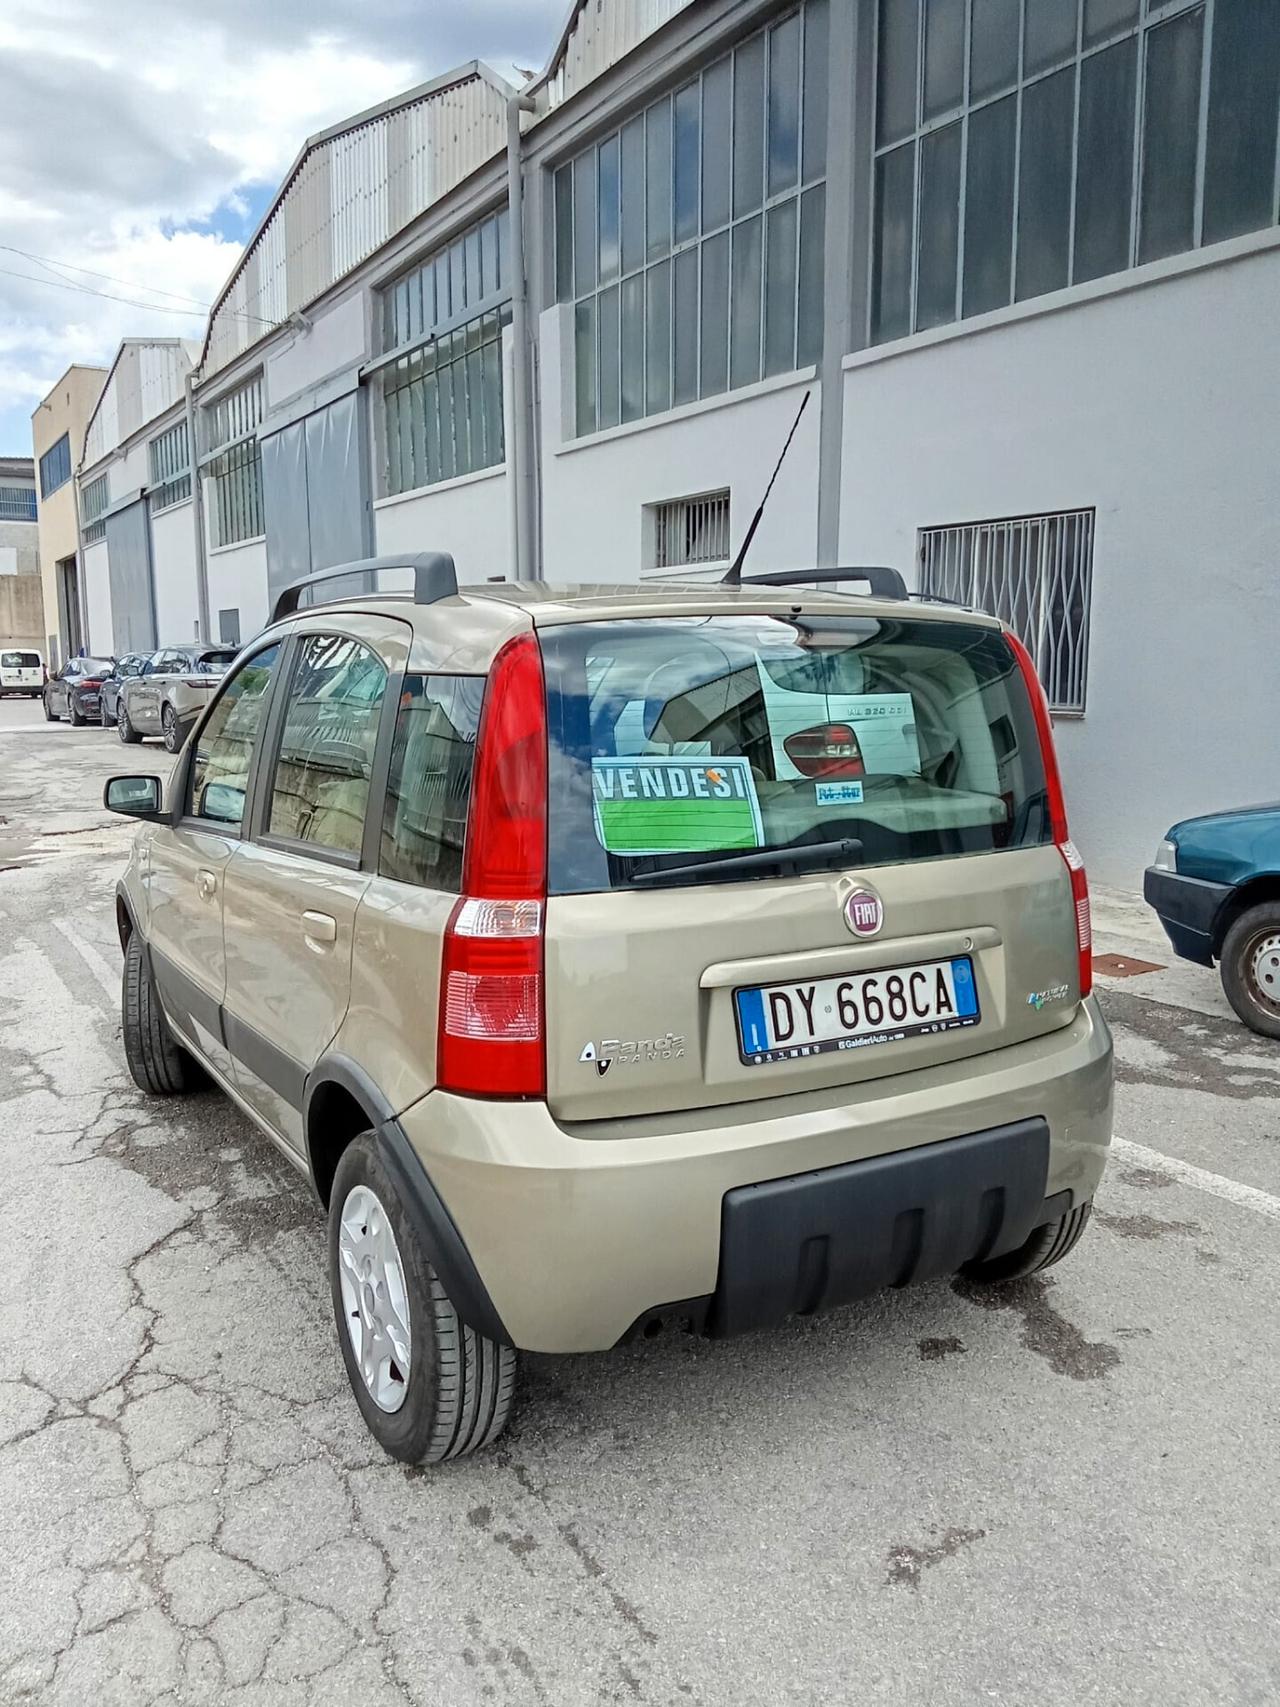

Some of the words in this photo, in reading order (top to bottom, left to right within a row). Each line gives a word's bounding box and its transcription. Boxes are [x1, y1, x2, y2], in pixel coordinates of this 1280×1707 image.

[594, 766, 746, 799] VENDESI
[854, 902, 876, 925] FIAT
[768, 985, 816, 1042] DY
[836, 967, 954, 1030] 668CA
[616, 1048, 685, 1065] PANDA
